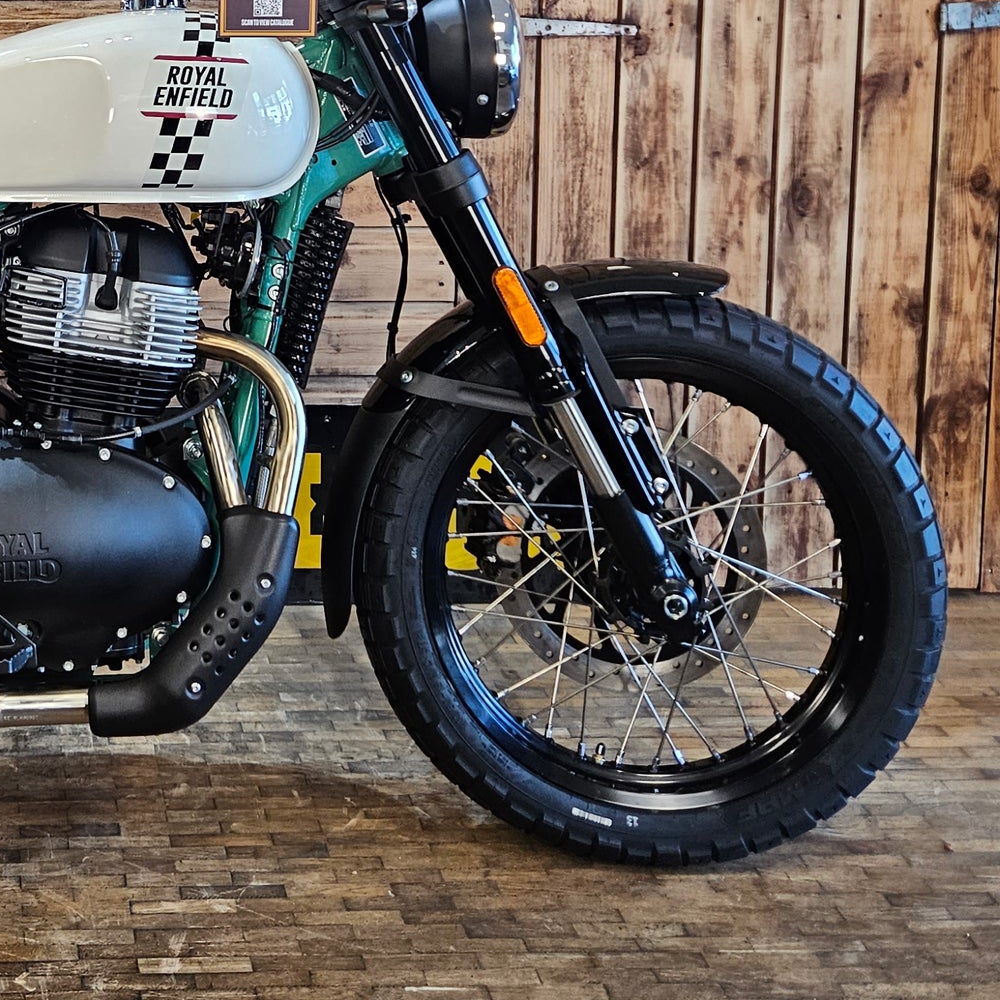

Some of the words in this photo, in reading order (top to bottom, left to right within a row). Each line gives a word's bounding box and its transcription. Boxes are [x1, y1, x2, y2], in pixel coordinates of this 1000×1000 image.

[241, 18, 254, 27] SCAN
[253, 18, 260, 27] TO
[259, 18, 270, 27] VIEW
[270, 18, 294, 27] CATALOGUE
[166, 65, 227, 87] ROYAL
[153, 86, 234, 109] ENFIELD
